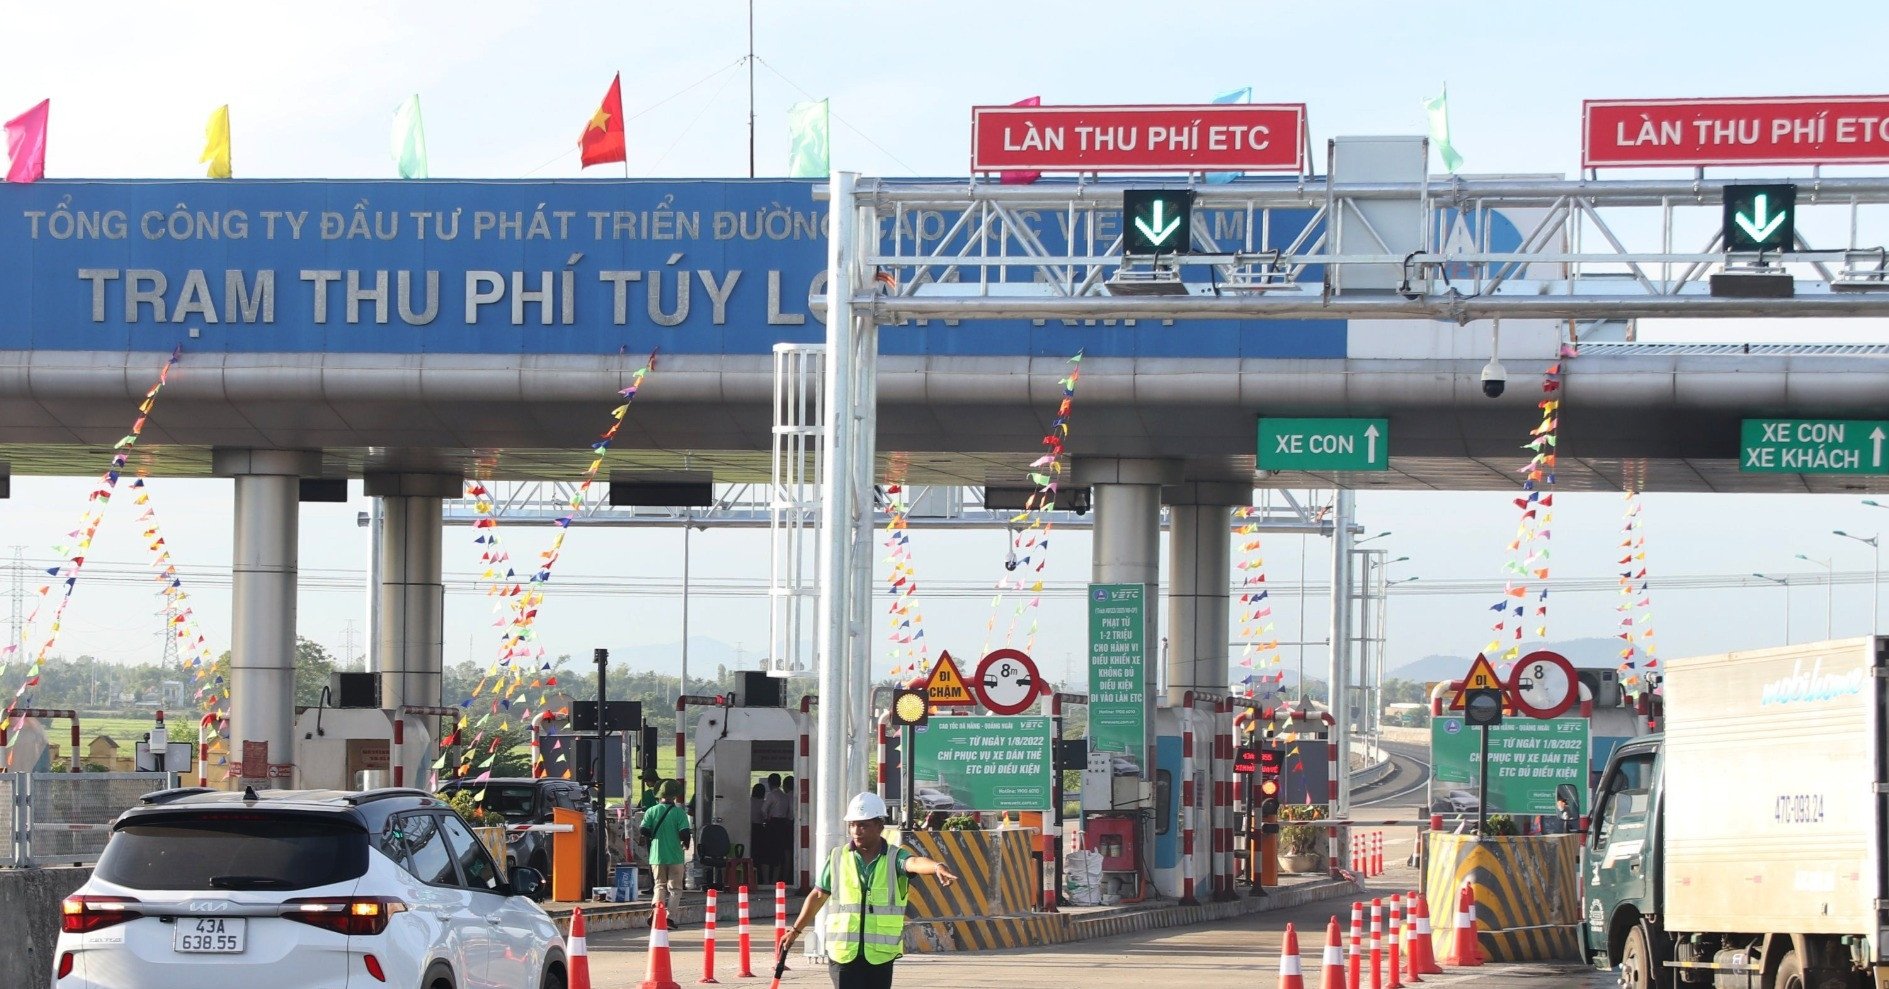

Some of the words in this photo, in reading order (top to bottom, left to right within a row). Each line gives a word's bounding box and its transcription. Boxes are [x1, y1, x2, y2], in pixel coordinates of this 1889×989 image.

[1003, 120, 1064, 151] LÀN
[1075, 126, 1137, 151] THU
[1148, 118, 1200, 151] PHÍ
[1207, 125, 1270, 150] ETC
[1616, 113, 1688, 147] LÀN
[1697, 120, 1760, 146] THU
[1771, 111, 1828, 145] PHÍ
[24, 193, 128, 241] TỔNG
[141, 204, 249, 241] CÔNG
[259, 210, 304, 240] TY
[320, 198, 399, 241] ĐẦU
[410, 206, 462, 241] TƯ
[473, 203, 576, 241] PHÁT
[587, 194, 700, 241] TRIỂN
[78, 267, 275, 338] TRẠM
[300, 269, 440, 326] THU
[465, 252, 584, 325] PHÍ
[599, 252, 743, 327] TÚY
[1761, 423, 1790, 443] XE
[1797, 423, 1844, 444] CON
[1275, 434, 1303, 455] XE
[1308, 434, 1354, 455] CON
[1745, 449, 1775, 468] XE
[1781, 444, 1859, 469] KHÁCH
[1099, 631, 1111, 640] 1-2
[1093, 643, 1109, 652] CHO
[1131, 643, 1139, 652] VI
[1131, 656, 1141, 665] XE
[939, 671, 950, 682] ĐI
[929, 686, 962, 699] CHẬM
[1130, 693, 1143, 702] ETC
[981, 735, 1005, 746] NGÀY
[1516, 737, 1541, 749] NGÀY
[954, 750, 977, 762] PHỤC
[979, 750, 991, 762] VỤ
[993, 751, 1004, 760] XE
[1514, 753, 1525, 764] VỤ
[1527, 753, 1539, 763] XE
[966, 765, 982, 774] ETC
[1499, 767, 1516, 777] ETC
[196, 919, 225, 933] 43A
[182, 935, 237, 950] 638.55
